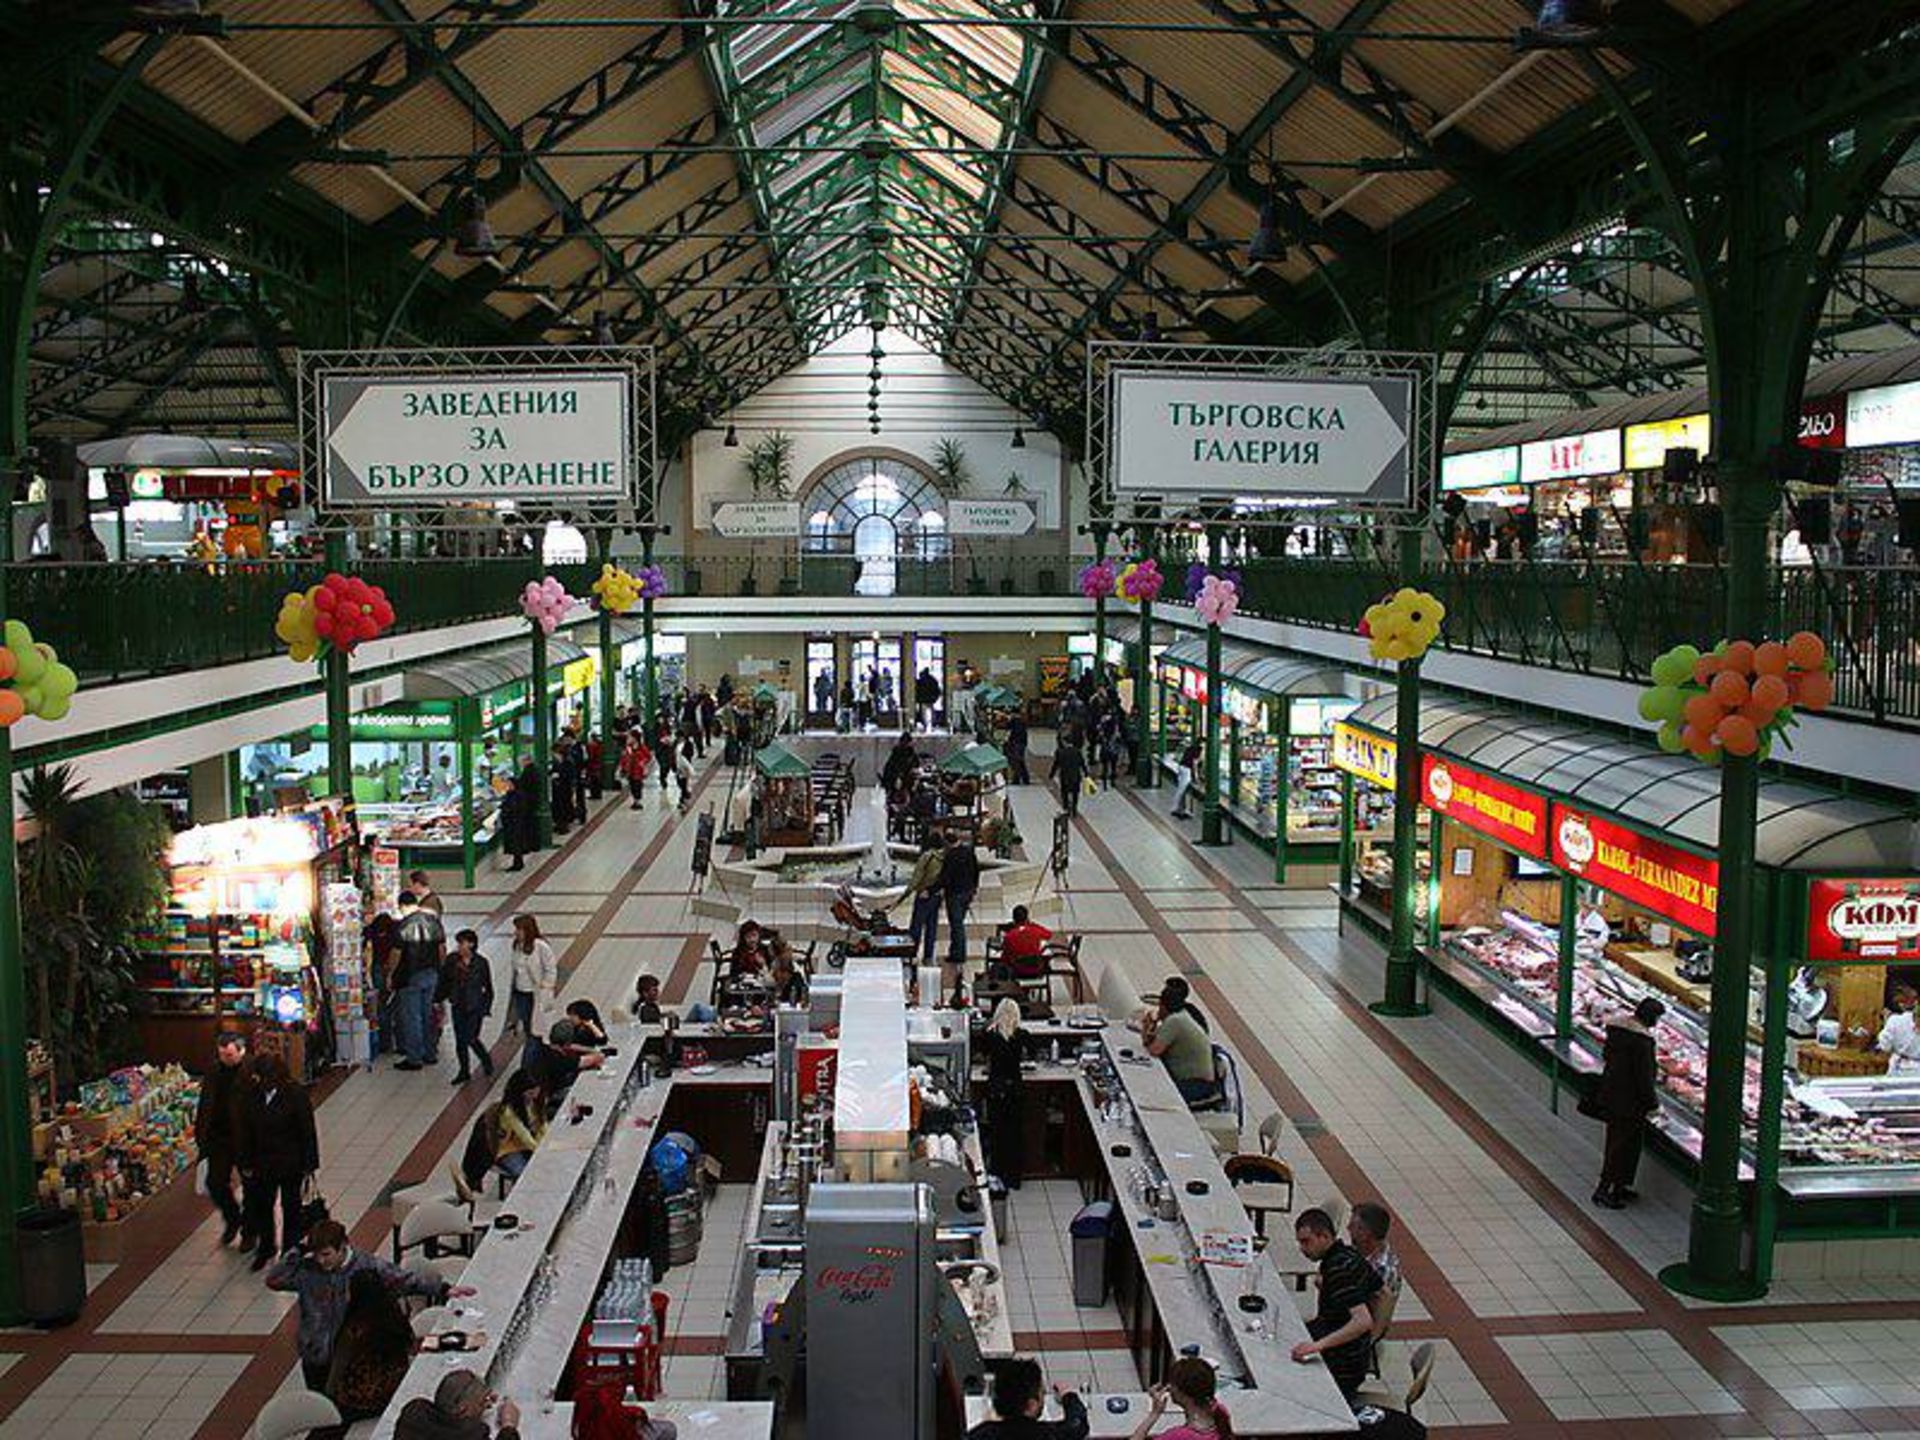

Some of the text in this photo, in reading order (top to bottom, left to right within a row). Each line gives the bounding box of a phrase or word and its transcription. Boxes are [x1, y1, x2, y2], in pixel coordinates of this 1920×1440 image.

[402, 390, 578, 418] ЗАВЕДЕНИЯ
[1168, 402, 1345, 431] ТЪРГОВСКА
[470, 426, 507, 451] ЗА
[1193, 438, 1320, 465] ГАЛЕРИЯ
[368, 462, 616, 489] БЪРЗО ХРАНЕНЕ
